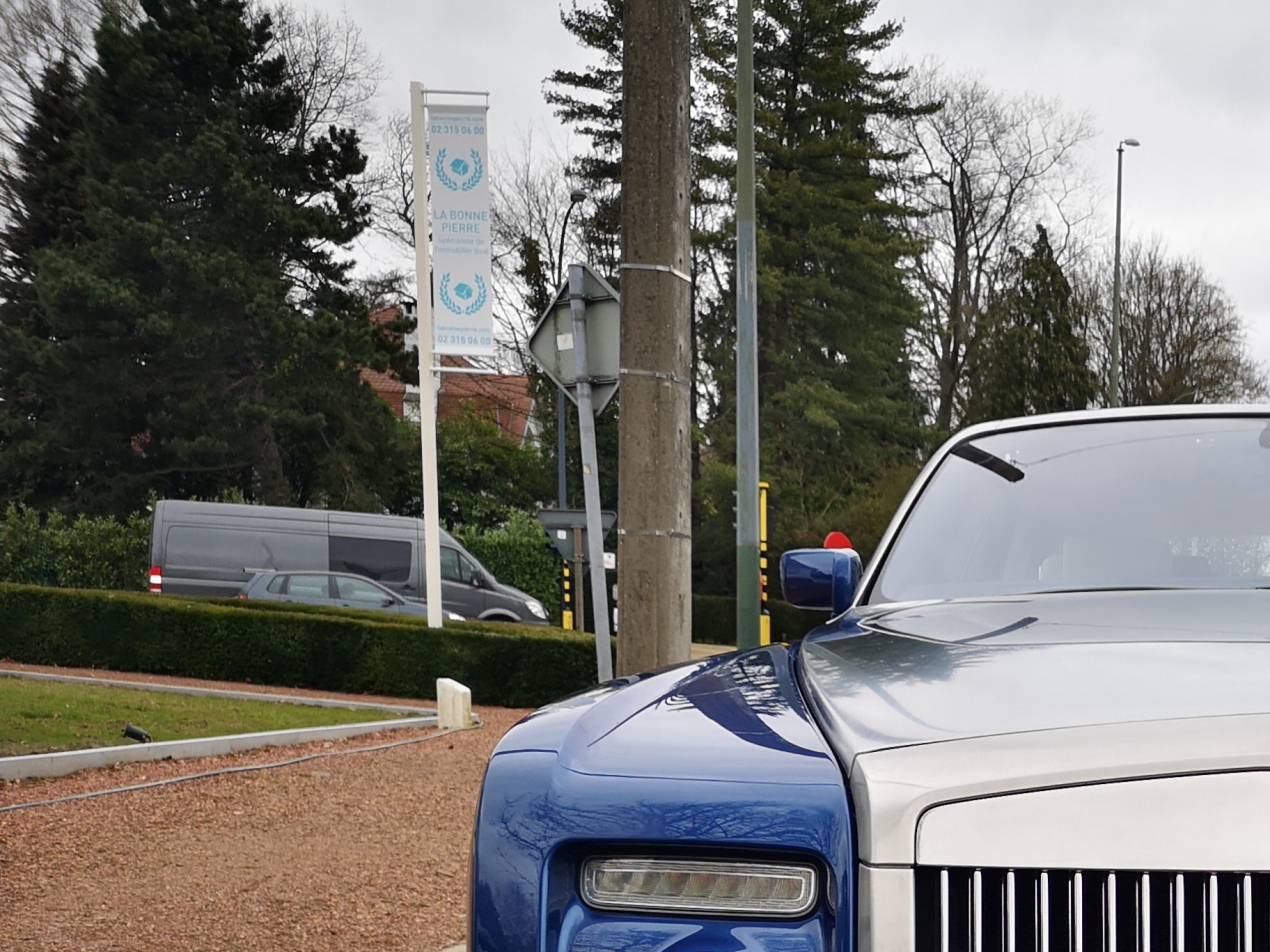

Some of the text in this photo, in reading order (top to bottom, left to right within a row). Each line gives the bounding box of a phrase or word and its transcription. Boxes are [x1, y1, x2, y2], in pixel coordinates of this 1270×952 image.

[431, 125, 485, 134] 02 315 06 00
[433, 210, 488, 221] LA BONNE
[441, 222, 480, 233] PIERRE
[437, 335, 491, 345] 02 315 06 00
